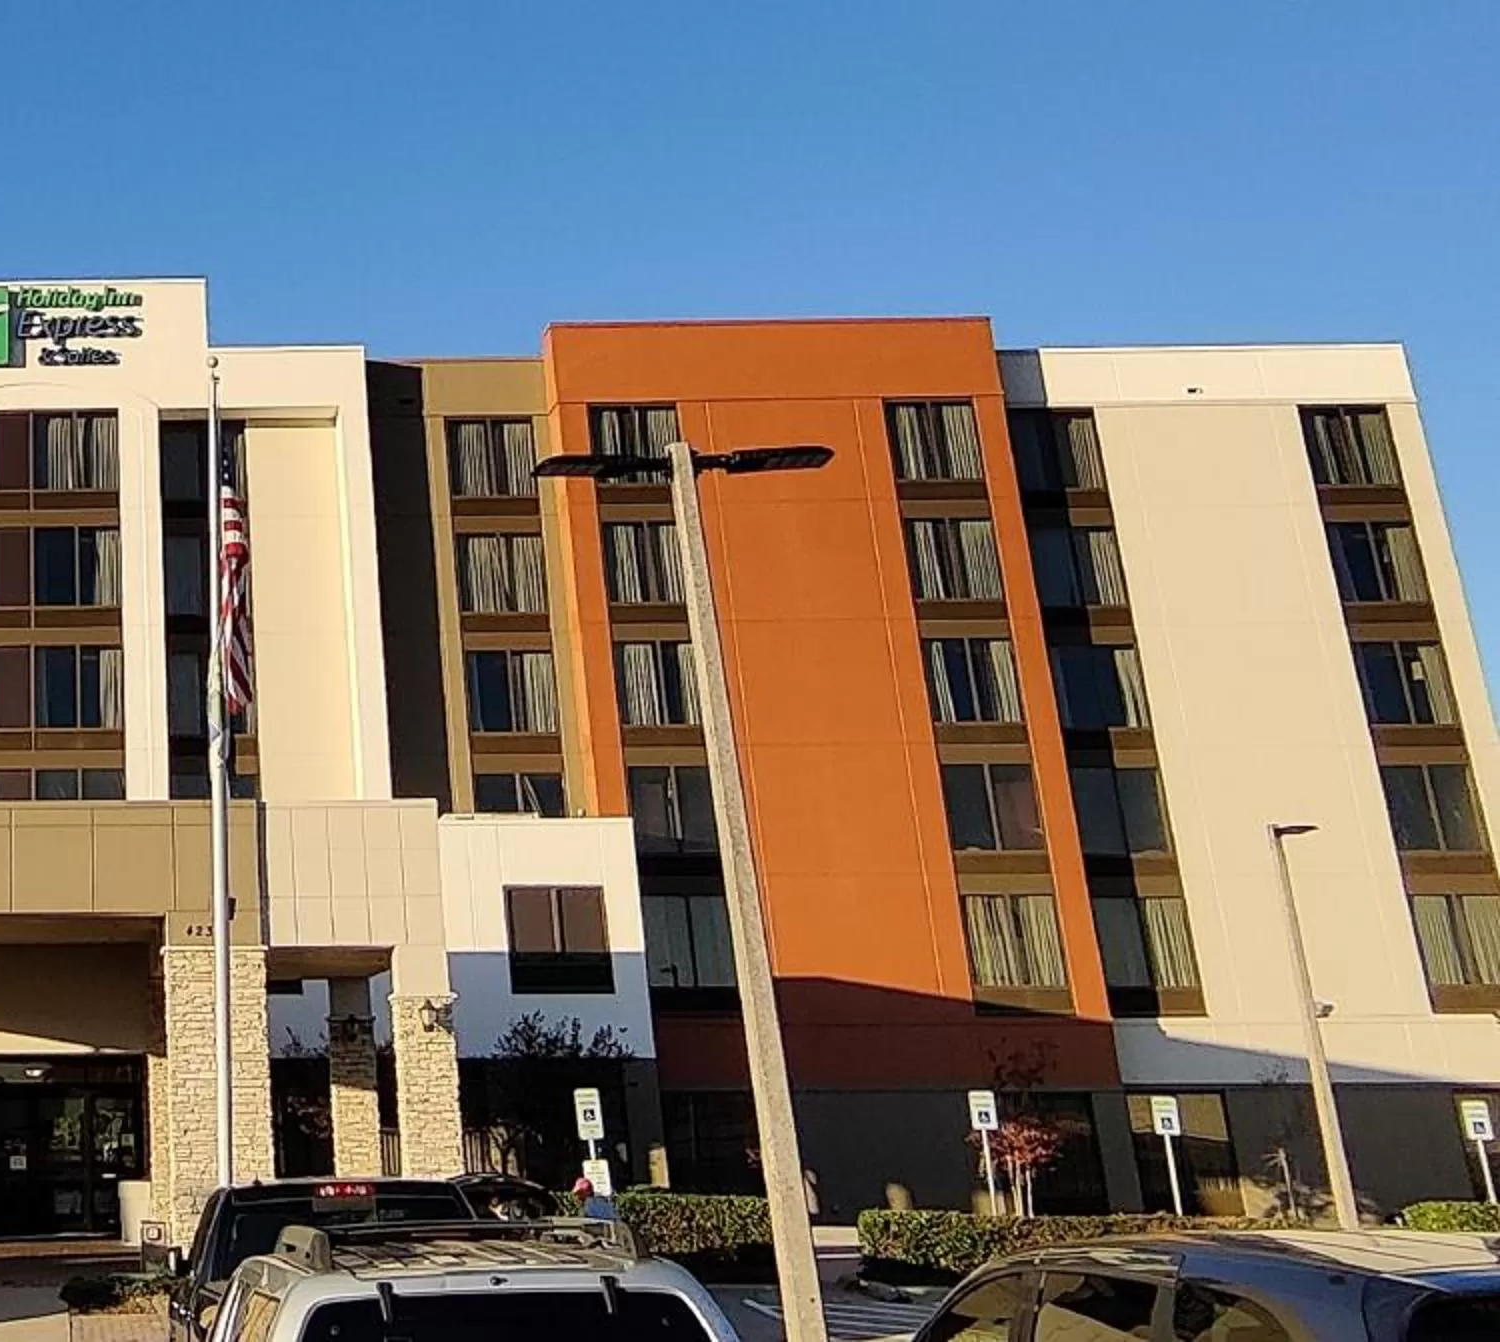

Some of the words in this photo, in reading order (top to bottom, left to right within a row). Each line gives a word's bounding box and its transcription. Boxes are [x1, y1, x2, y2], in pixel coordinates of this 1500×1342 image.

[17, 285, 102, 311] Holiday
[102, 285, 141, 306] Inn
[17, 310, 141, 345] Express
